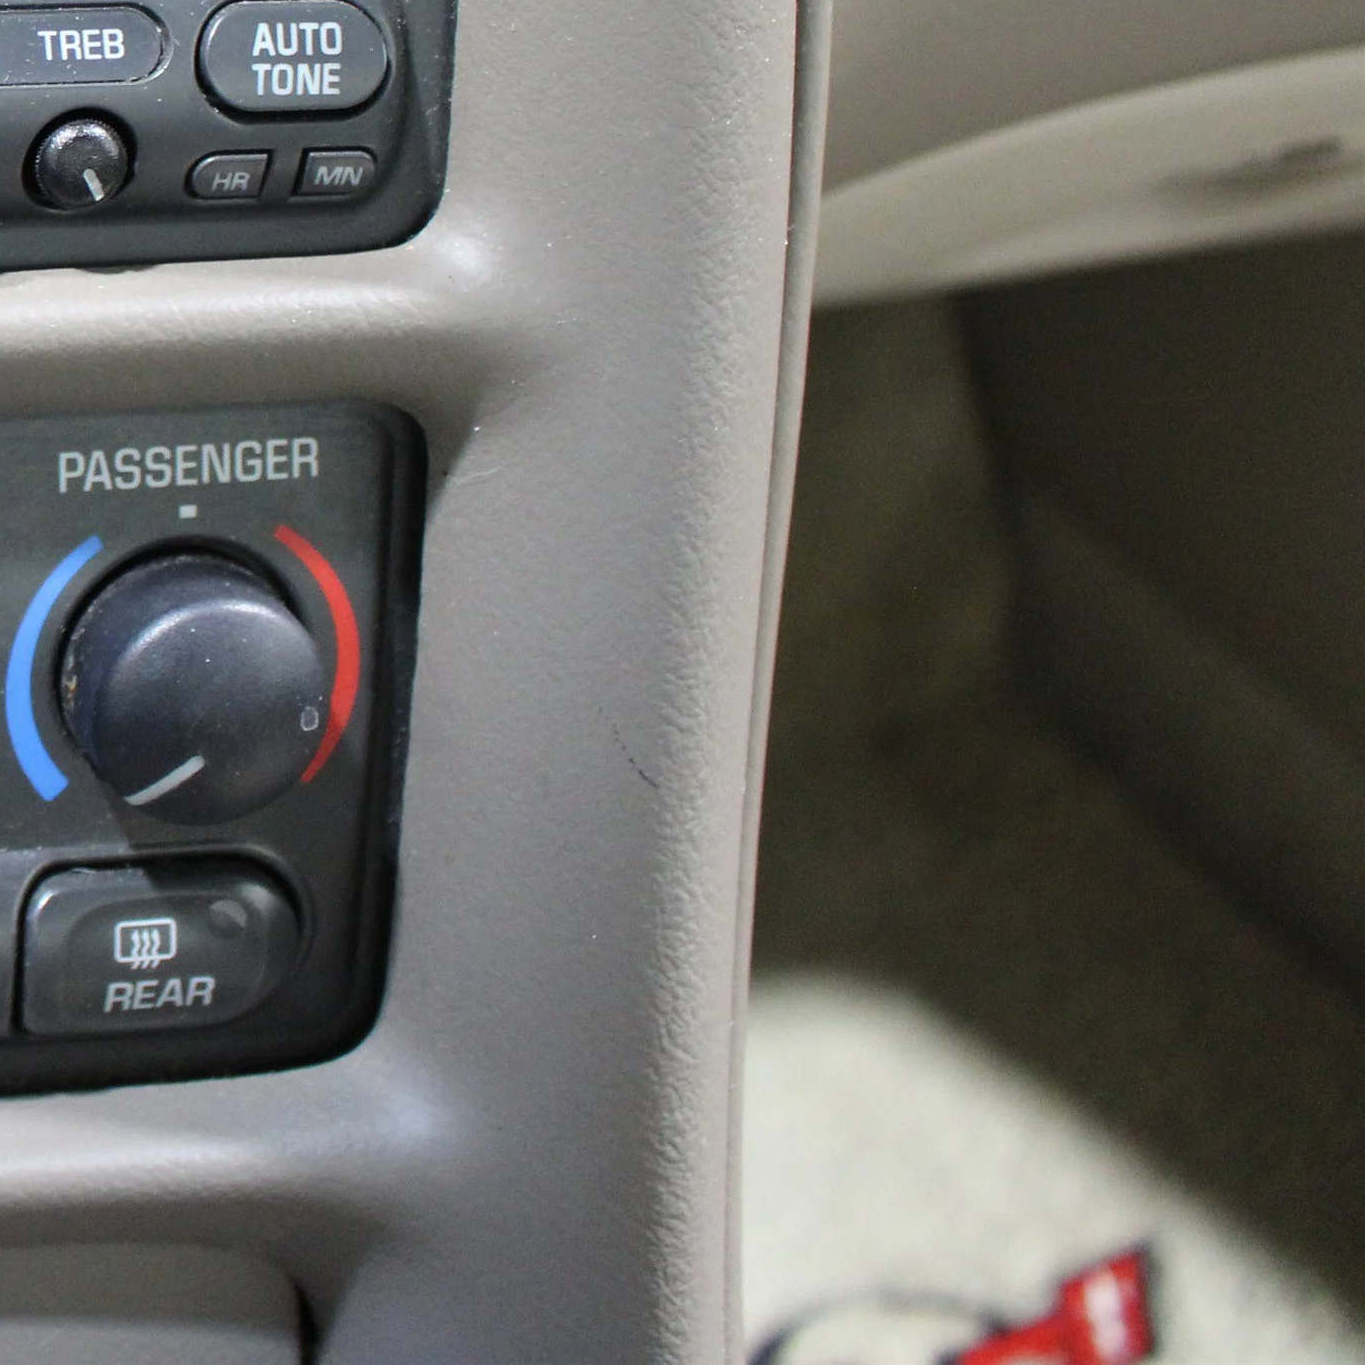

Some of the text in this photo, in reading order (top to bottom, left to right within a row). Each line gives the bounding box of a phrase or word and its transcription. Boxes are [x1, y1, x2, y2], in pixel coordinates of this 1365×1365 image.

[36, 28, 125, 61] TREB
[251, 21, 342, 57] AUTO
[251, 62, 341, 96] TONE
[212, 169, 251, 191] HR
[314, 164, 364, 186] MN
[58, 437, 319, 494] PASSENGER
[104, 974, 216, 1012] REAR
